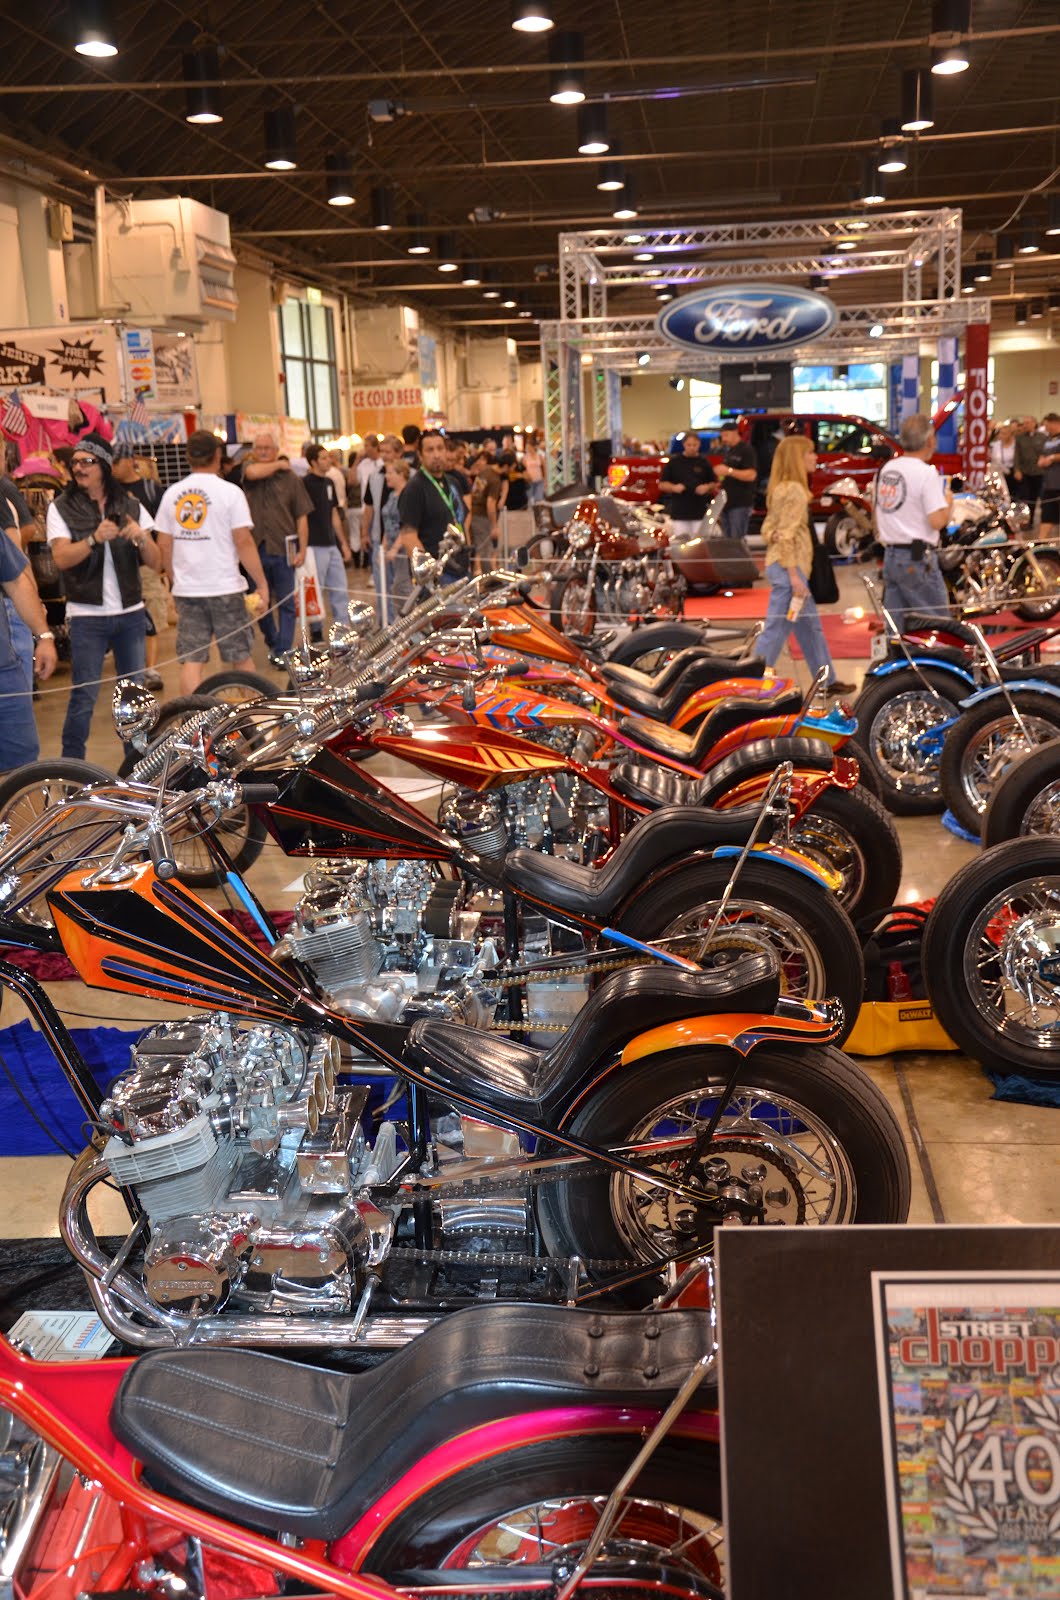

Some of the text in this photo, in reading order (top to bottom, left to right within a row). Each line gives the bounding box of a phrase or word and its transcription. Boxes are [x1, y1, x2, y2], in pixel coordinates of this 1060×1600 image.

[694, 299, 799, 343] Ford
[64, 346, 89, 359] FREE
[58, 356, 97, 369] SAMPLES
[353, 388, 422, 407] CE COLD BEER
[969, 368, 986, 491] FOCUS
[940, 1321, 1033, 1336] STREET
[901, 1306, 1060, 1375] chopp
[968, 1435, 1060, 1505] 40
[993, 1505, 1048, 1522] YEARS
